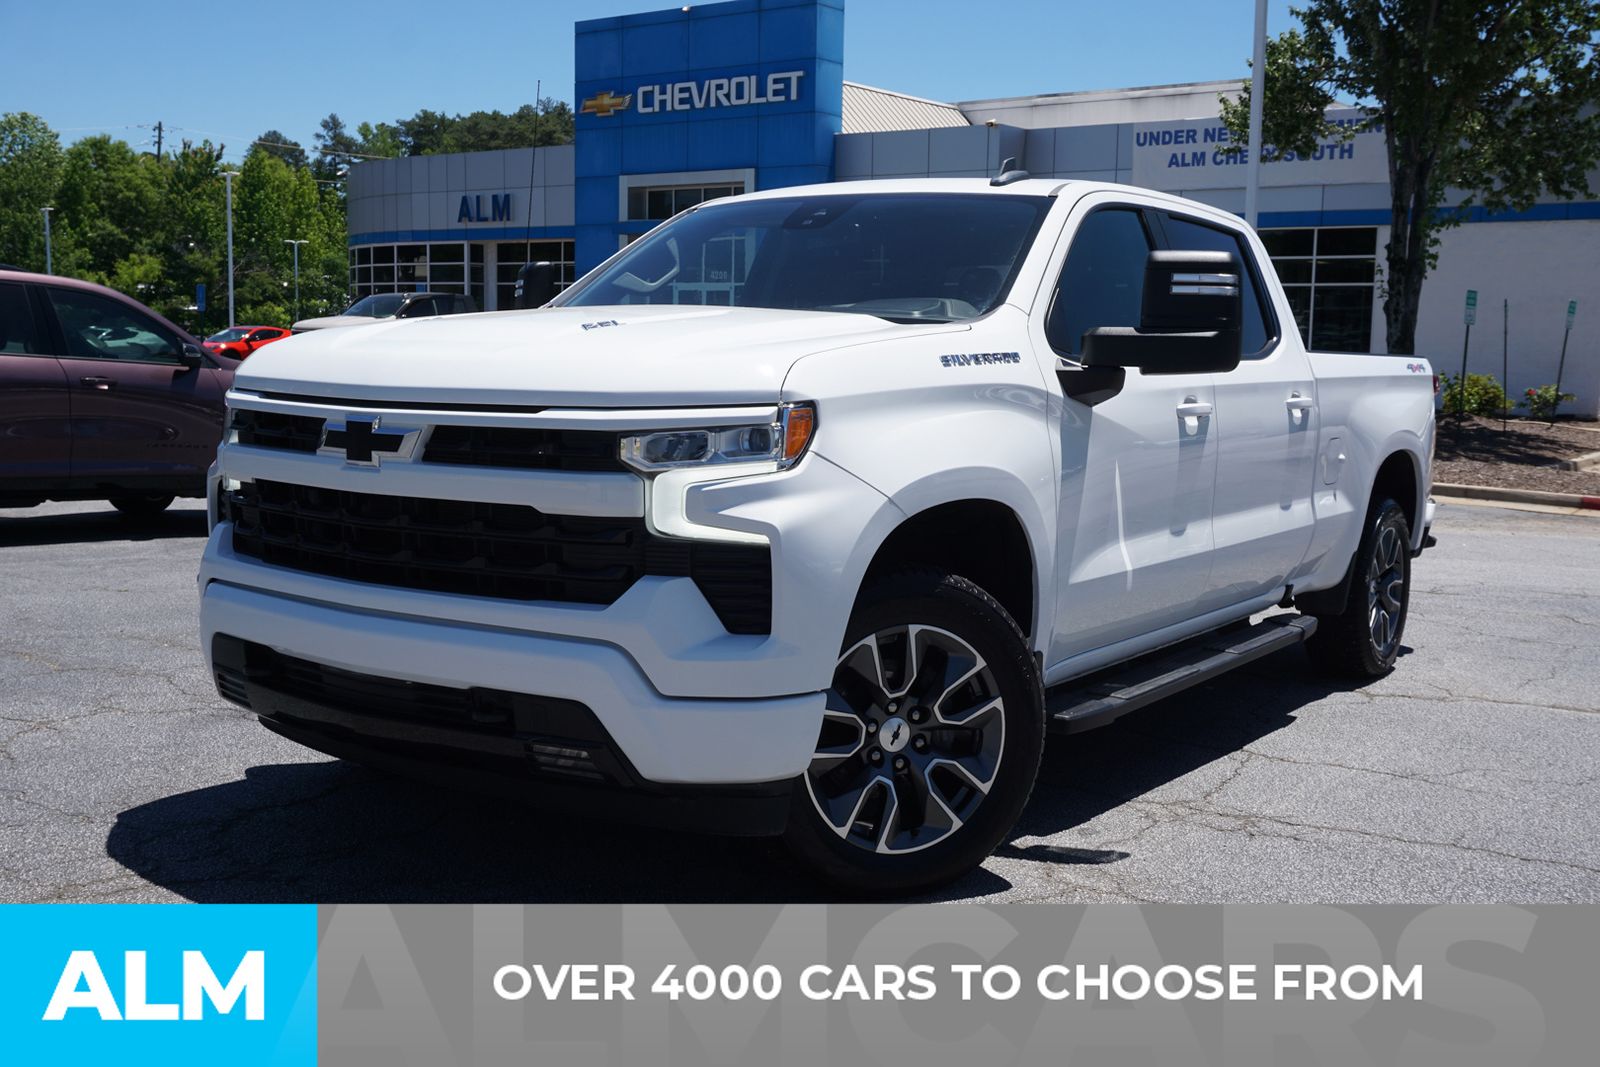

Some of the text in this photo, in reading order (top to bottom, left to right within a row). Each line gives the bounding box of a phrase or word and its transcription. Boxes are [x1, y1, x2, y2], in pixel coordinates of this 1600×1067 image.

[637, 70, 804, 114] CHEVROLET
[1136, 128, 1197, 147] UNDER
[1168, 151, 1206, 168] ALM
[457, 192, 512, 223] ALM
